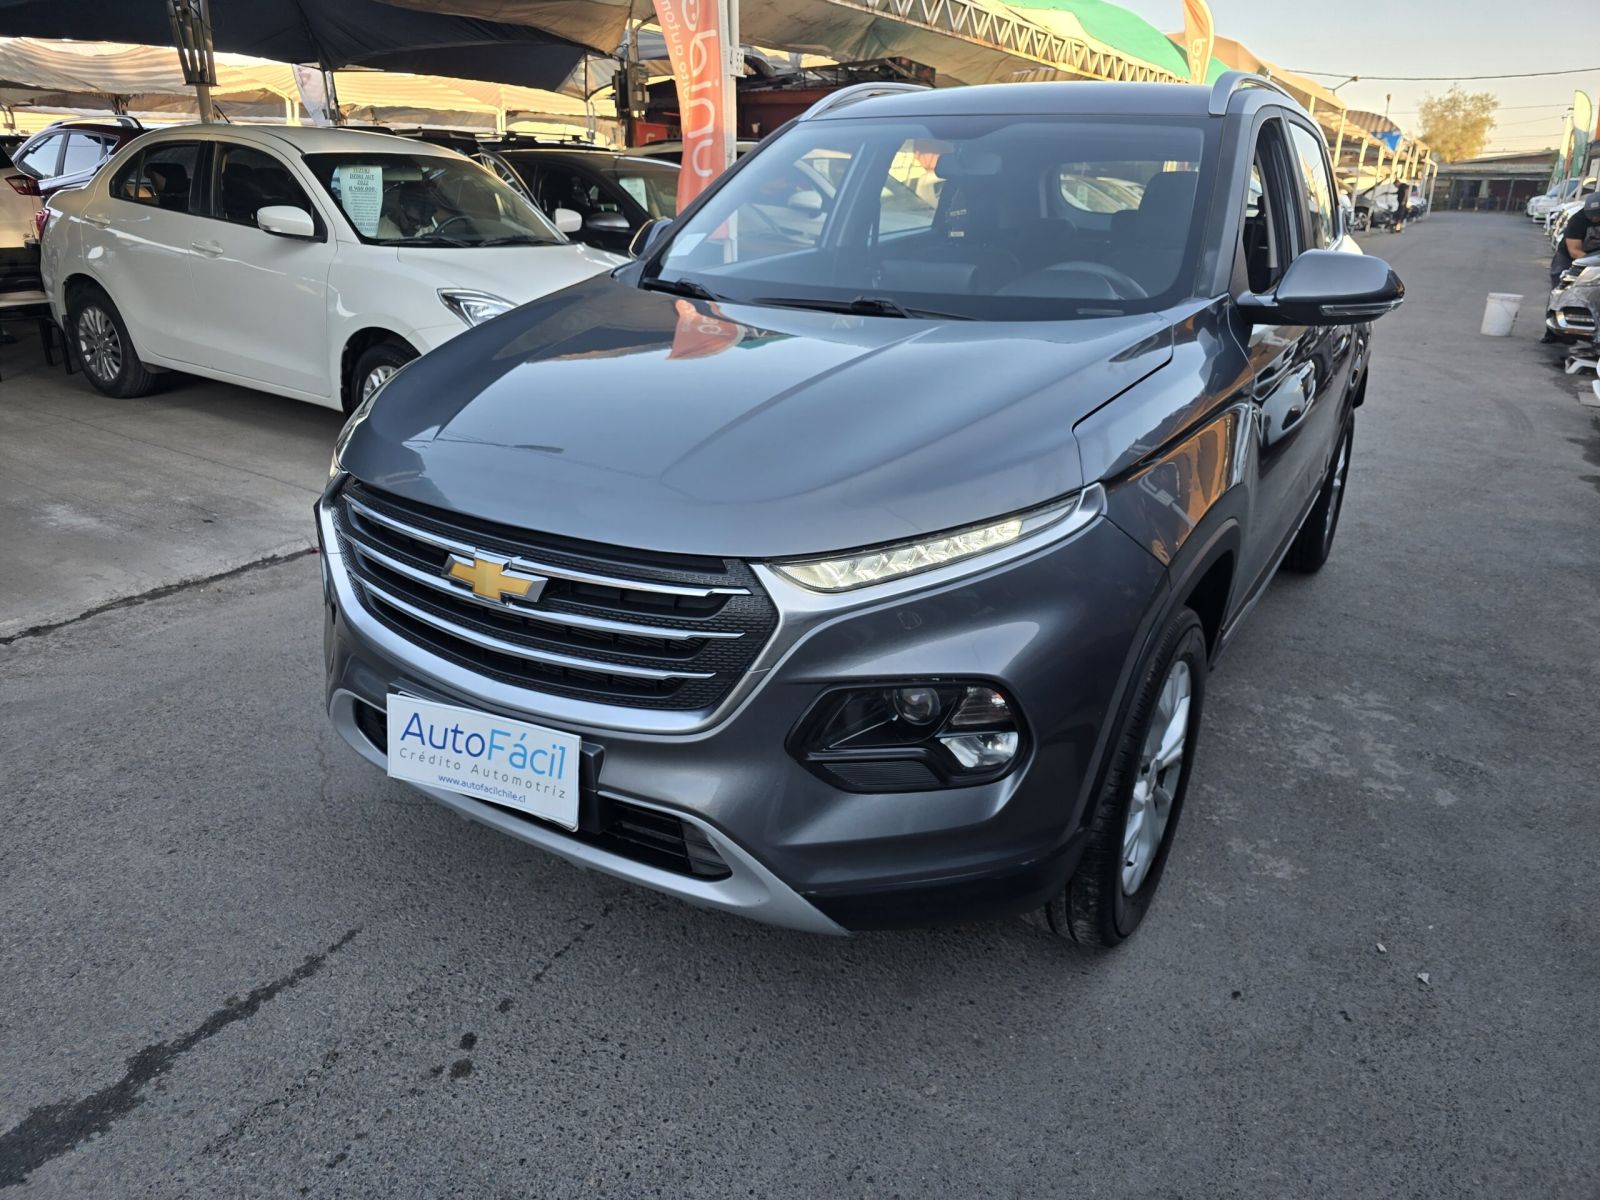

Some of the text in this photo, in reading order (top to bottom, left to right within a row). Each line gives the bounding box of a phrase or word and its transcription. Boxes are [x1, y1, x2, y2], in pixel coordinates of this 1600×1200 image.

[400, 712, 566, 780] AutoFácil
[399, 747, 566, 799] Crédito Automotriz
[438, 774, 526, 804] www.autofacilchile.cl
